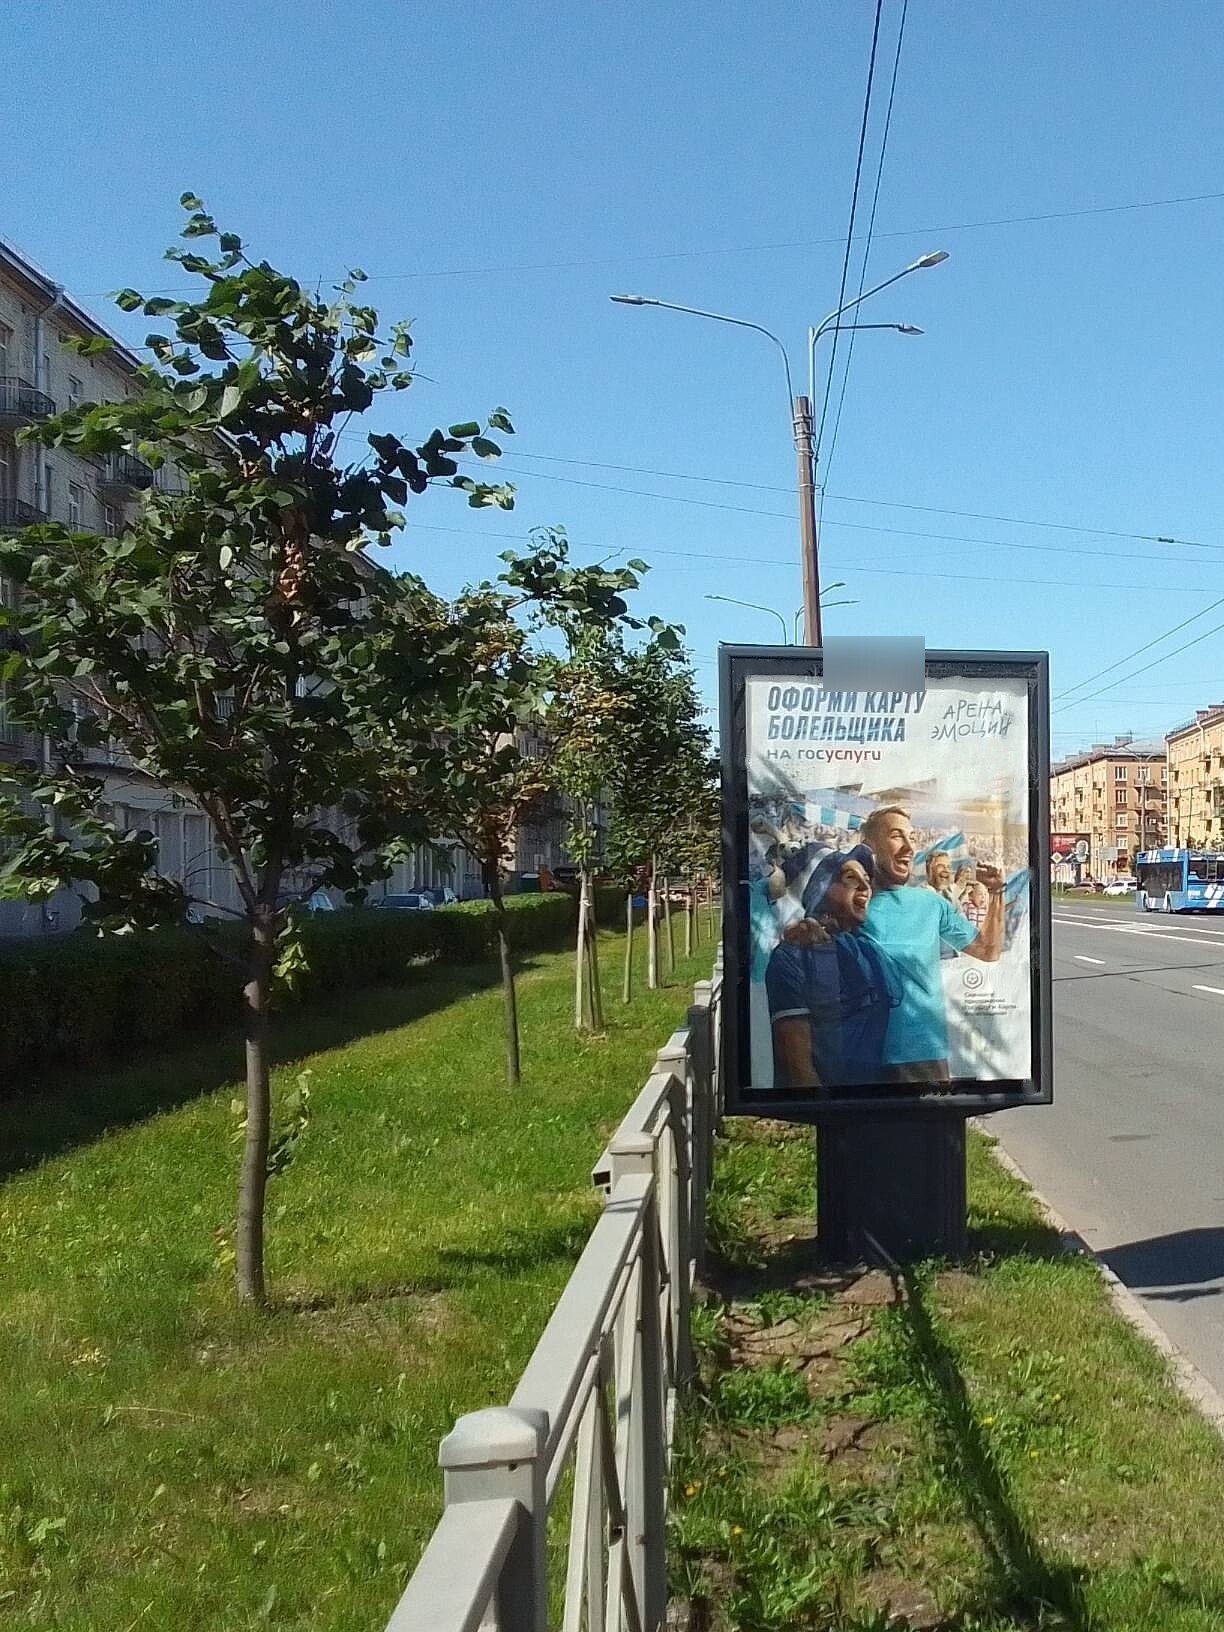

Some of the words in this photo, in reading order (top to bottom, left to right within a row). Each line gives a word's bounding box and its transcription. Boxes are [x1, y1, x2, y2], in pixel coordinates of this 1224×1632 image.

[767, 686, 857, 713] ОФОРМИ
[864, 691, 927, 714] КАРТУ
[942, 699, 1002, 721] АРЕНА
[767, 715, 906, 744] БОЛЕЛЬЩИКА
